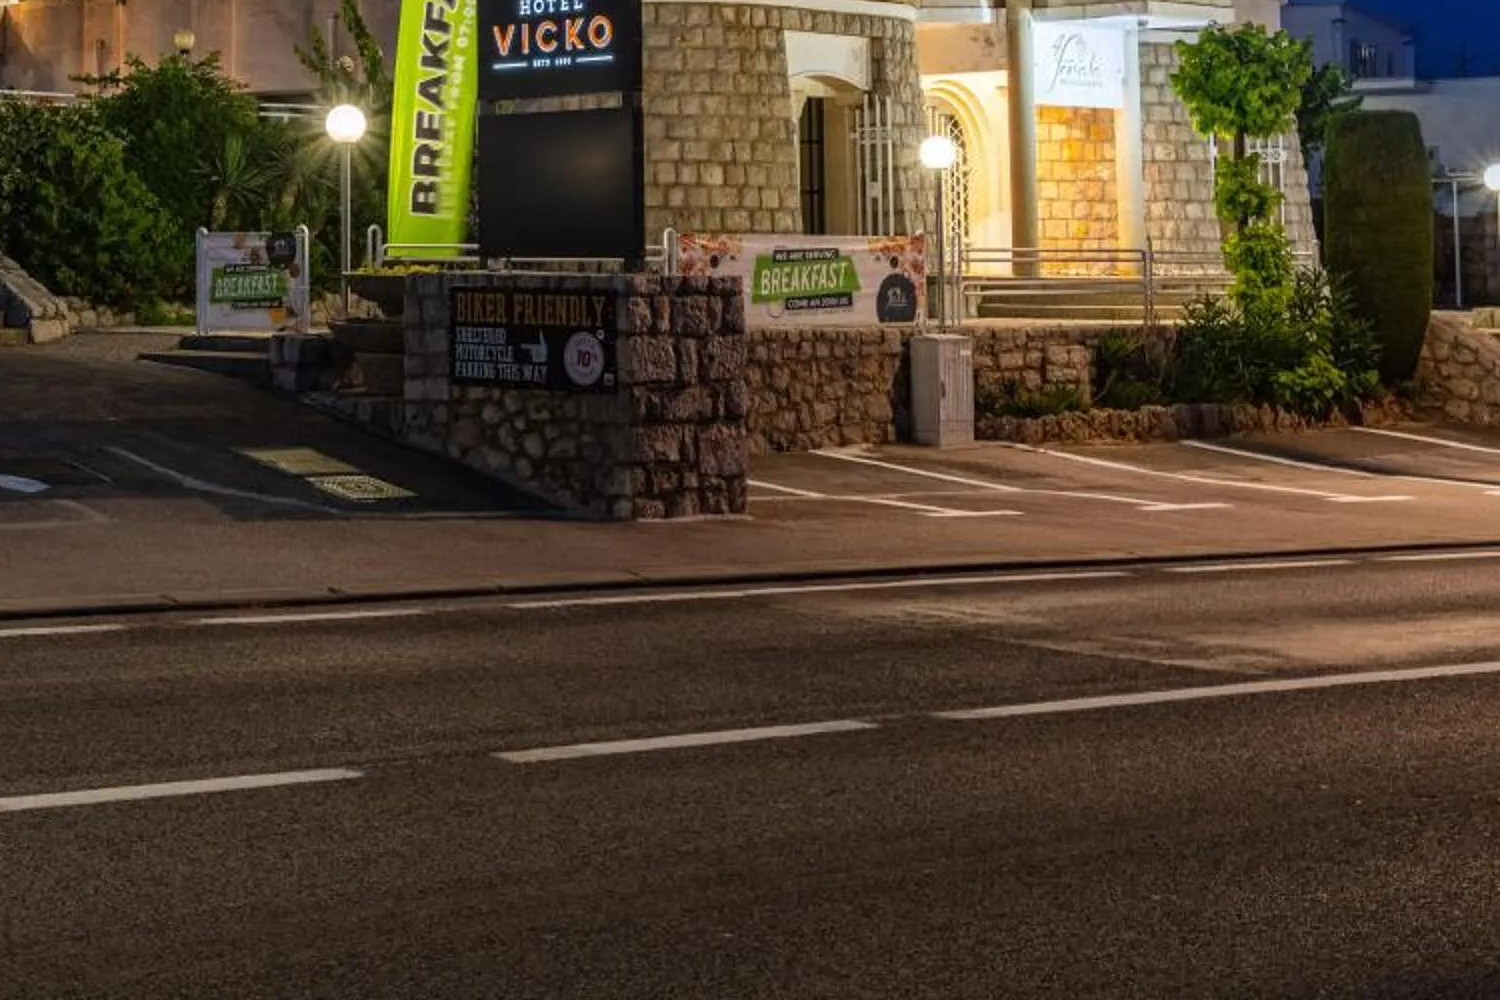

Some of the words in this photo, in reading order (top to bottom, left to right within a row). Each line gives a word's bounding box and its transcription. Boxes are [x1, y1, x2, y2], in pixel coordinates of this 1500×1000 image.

[492, 14, 613, 57] VICKO
[215, 273, 278, 298] BREAKFAST
[760, 262, 849, 296] BREAKFAST
[455, 291, 507, 323] BIKER
[512, 293, 606, 327] FRIENDLY
